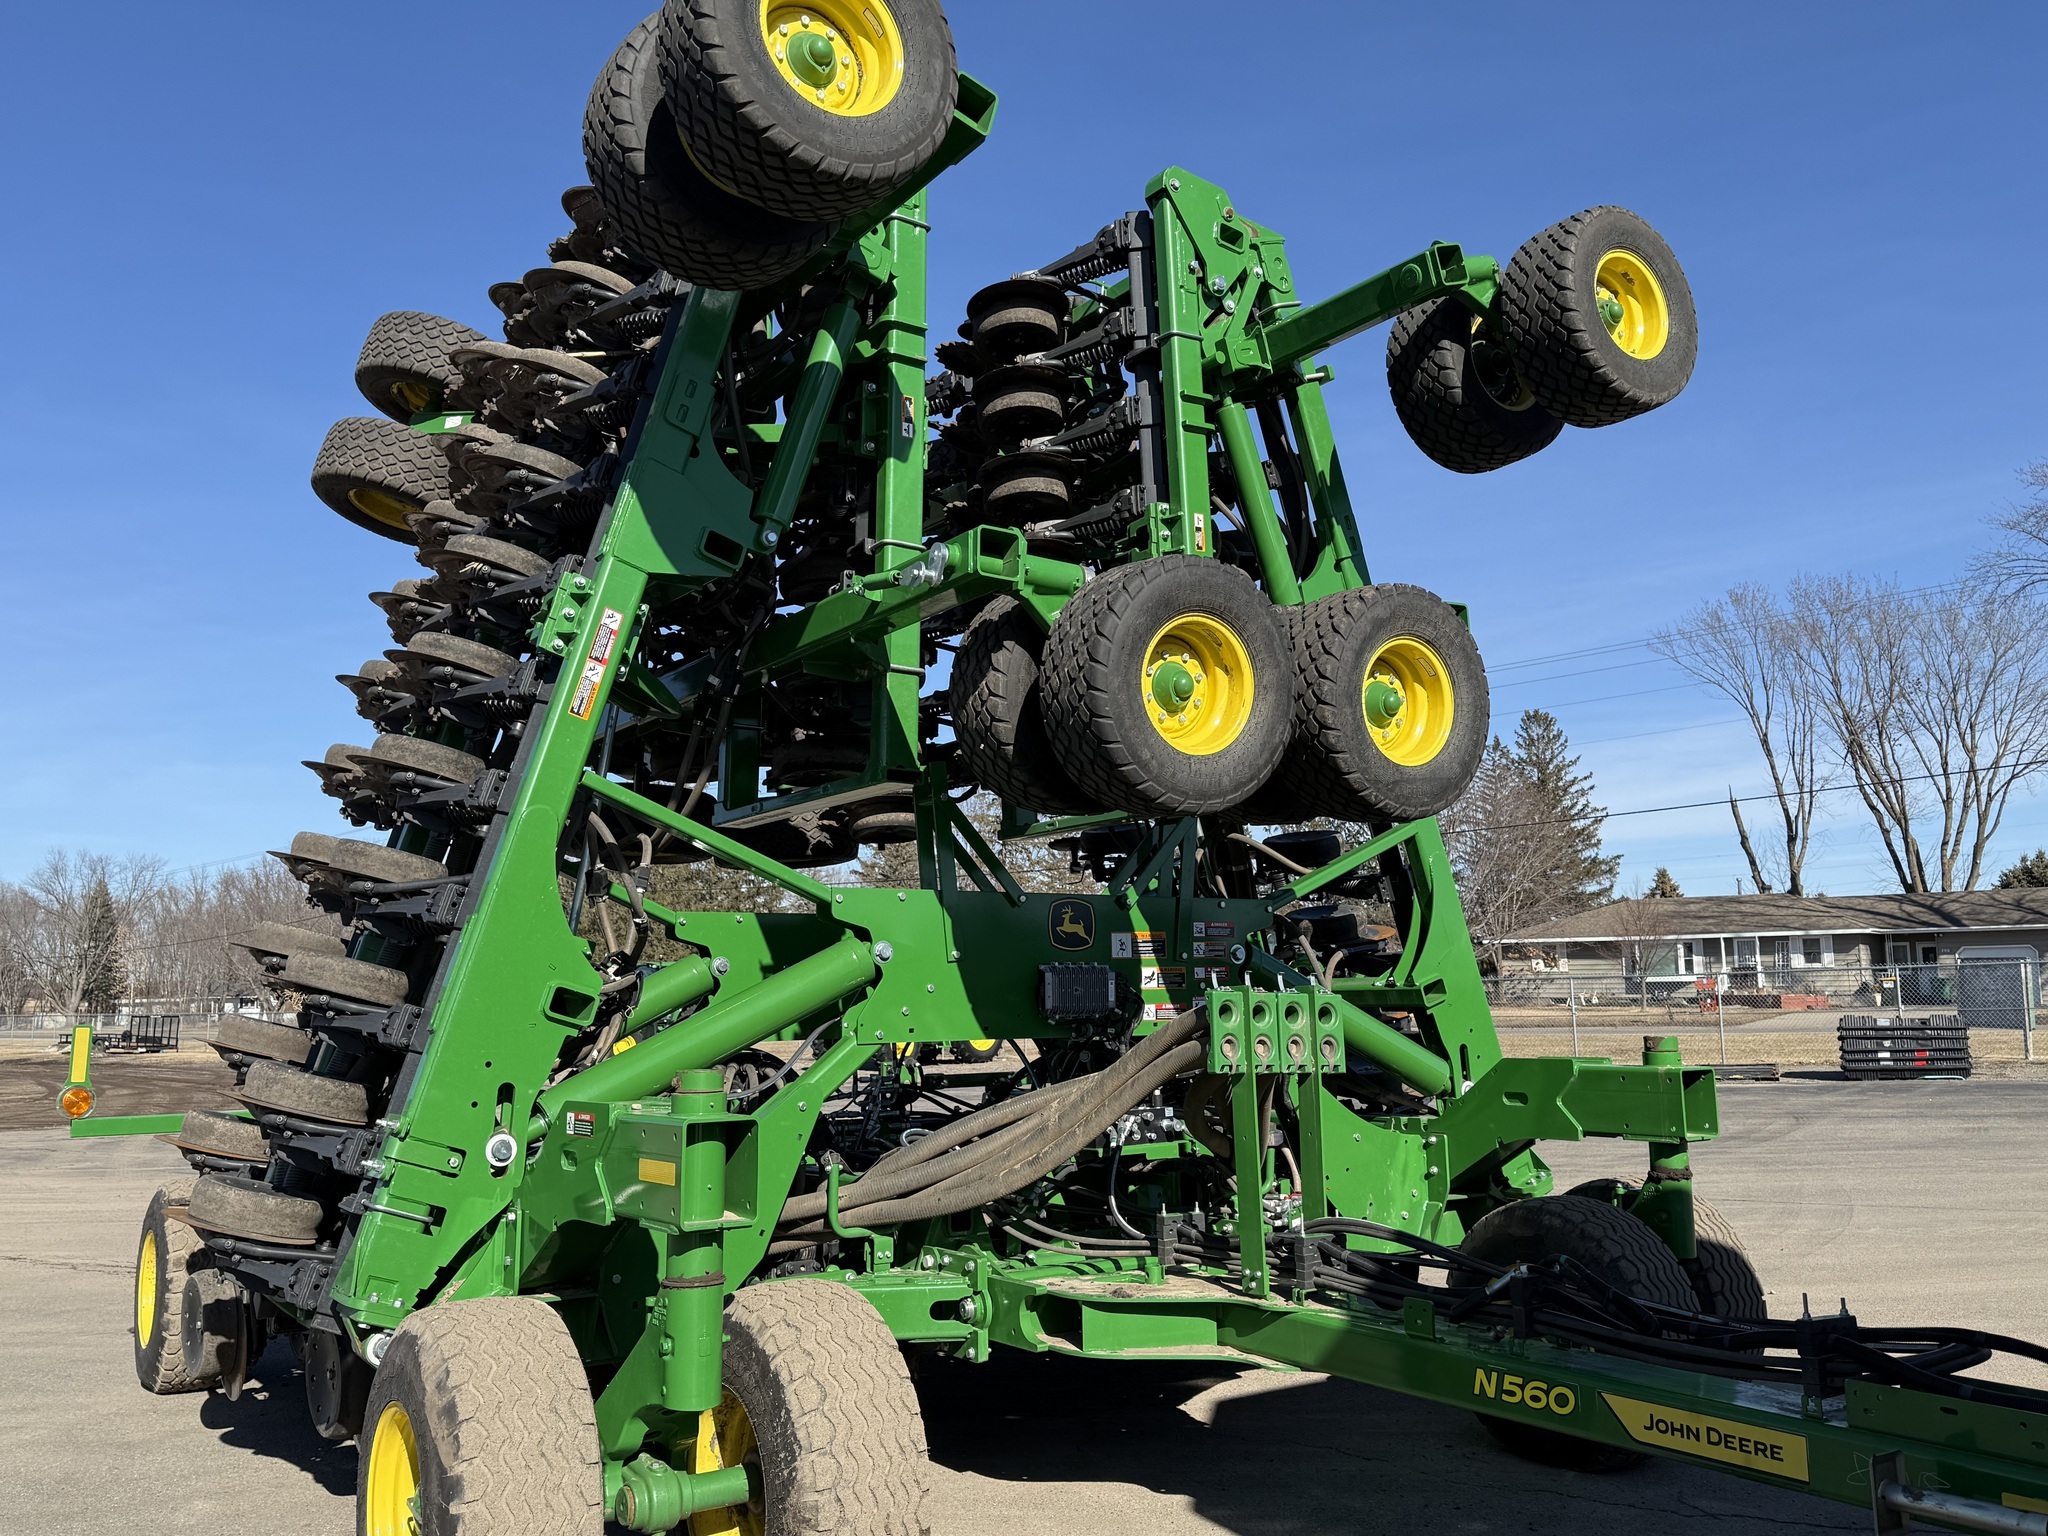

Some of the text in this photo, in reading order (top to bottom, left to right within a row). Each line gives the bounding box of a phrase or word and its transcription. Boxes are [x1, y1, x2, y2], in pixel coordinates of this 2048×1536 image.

[1473, 1367, 1577, 1416] N560
[1643, 1413, 1784, 1463] JOHN DEERE
